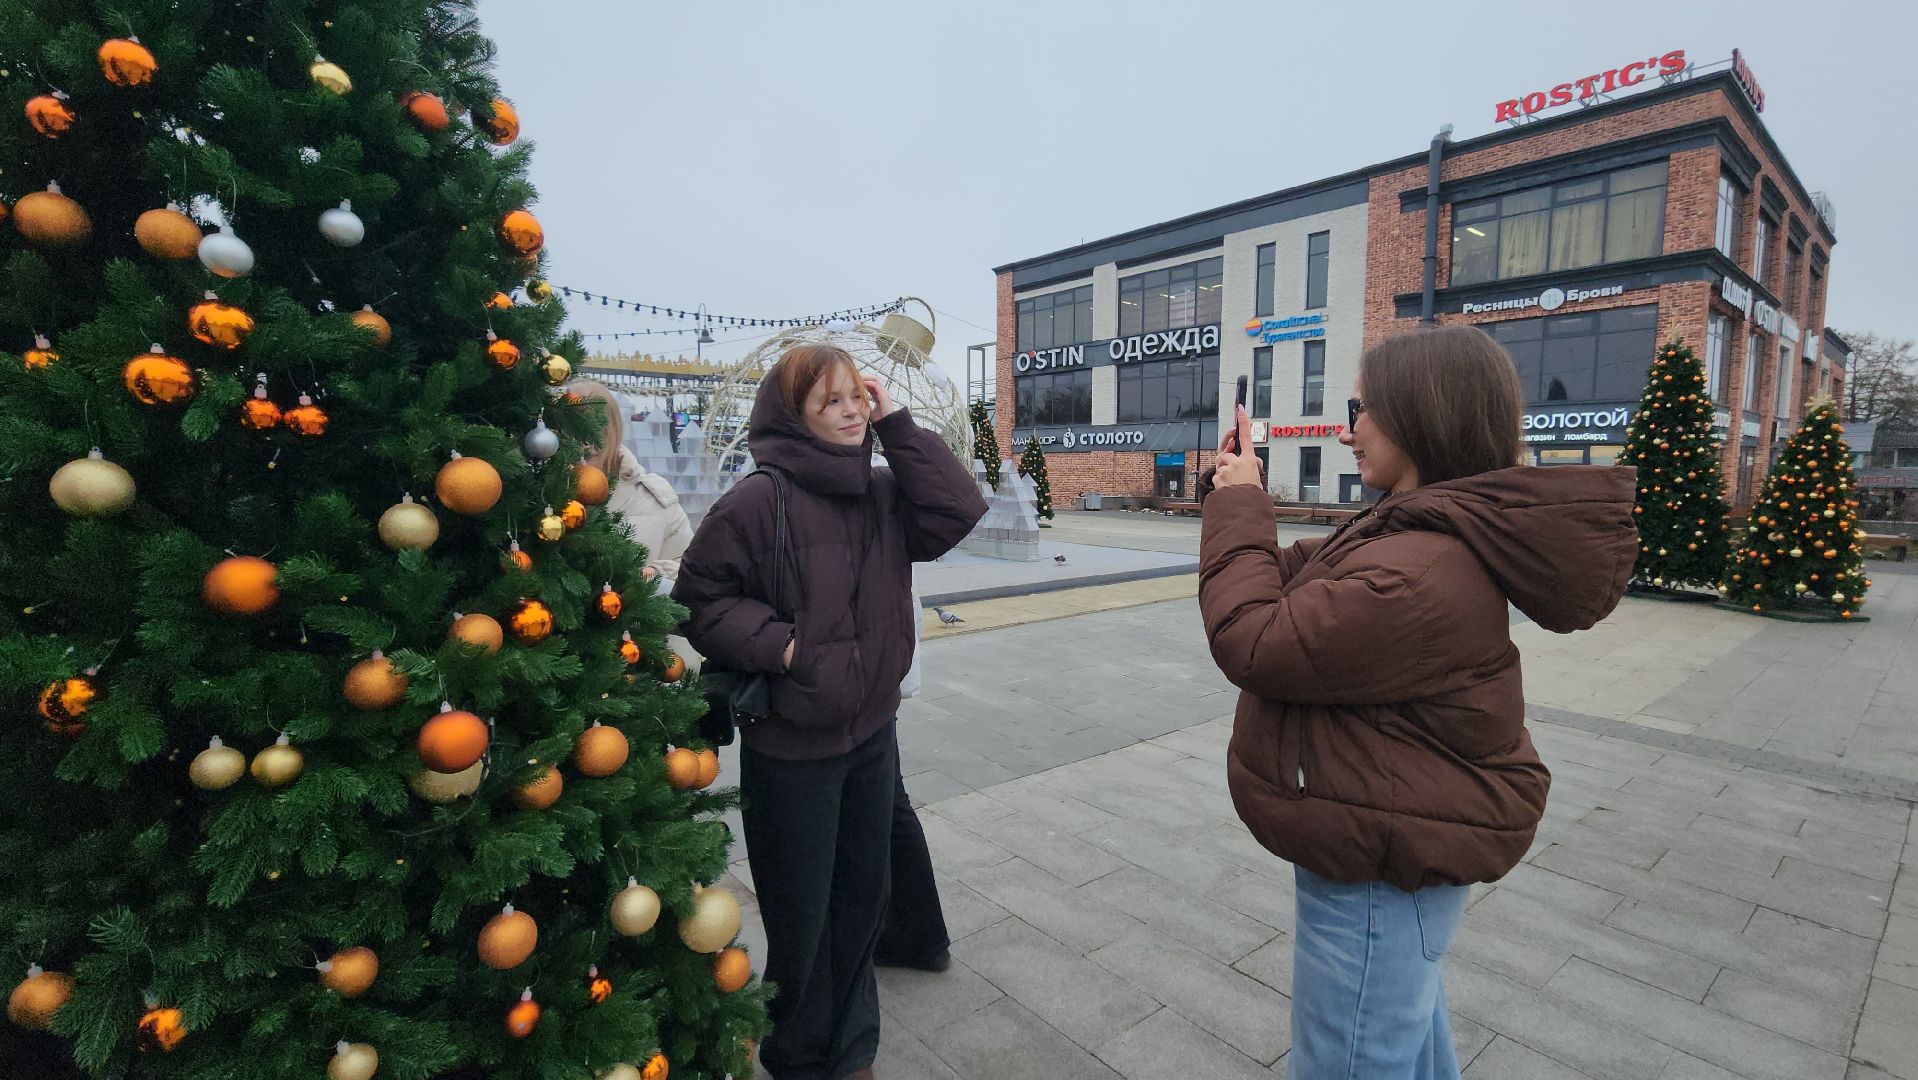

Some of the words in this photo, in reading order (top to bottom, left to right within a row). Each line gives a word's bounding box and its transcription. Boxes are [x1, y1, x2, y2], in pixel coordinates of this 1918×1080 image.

[1495, 50, 1686, 123] ROSTIC'S
[1463, 296, 1538, 314] Ресницы
[1567, 285, 1623, 302] Брови
[1109, 325, 1219, 362] одежда
[1016, 345, 1085, 372] O'STIN
[1522, 408, 1628, 429] ЗОЛОТОЙ
[1011, 435, 1056, 446] МАНКЮР
[1080, 431, 1144, 445] СТОЛОТО
[1564, 433, 1608, 441] ломбард
